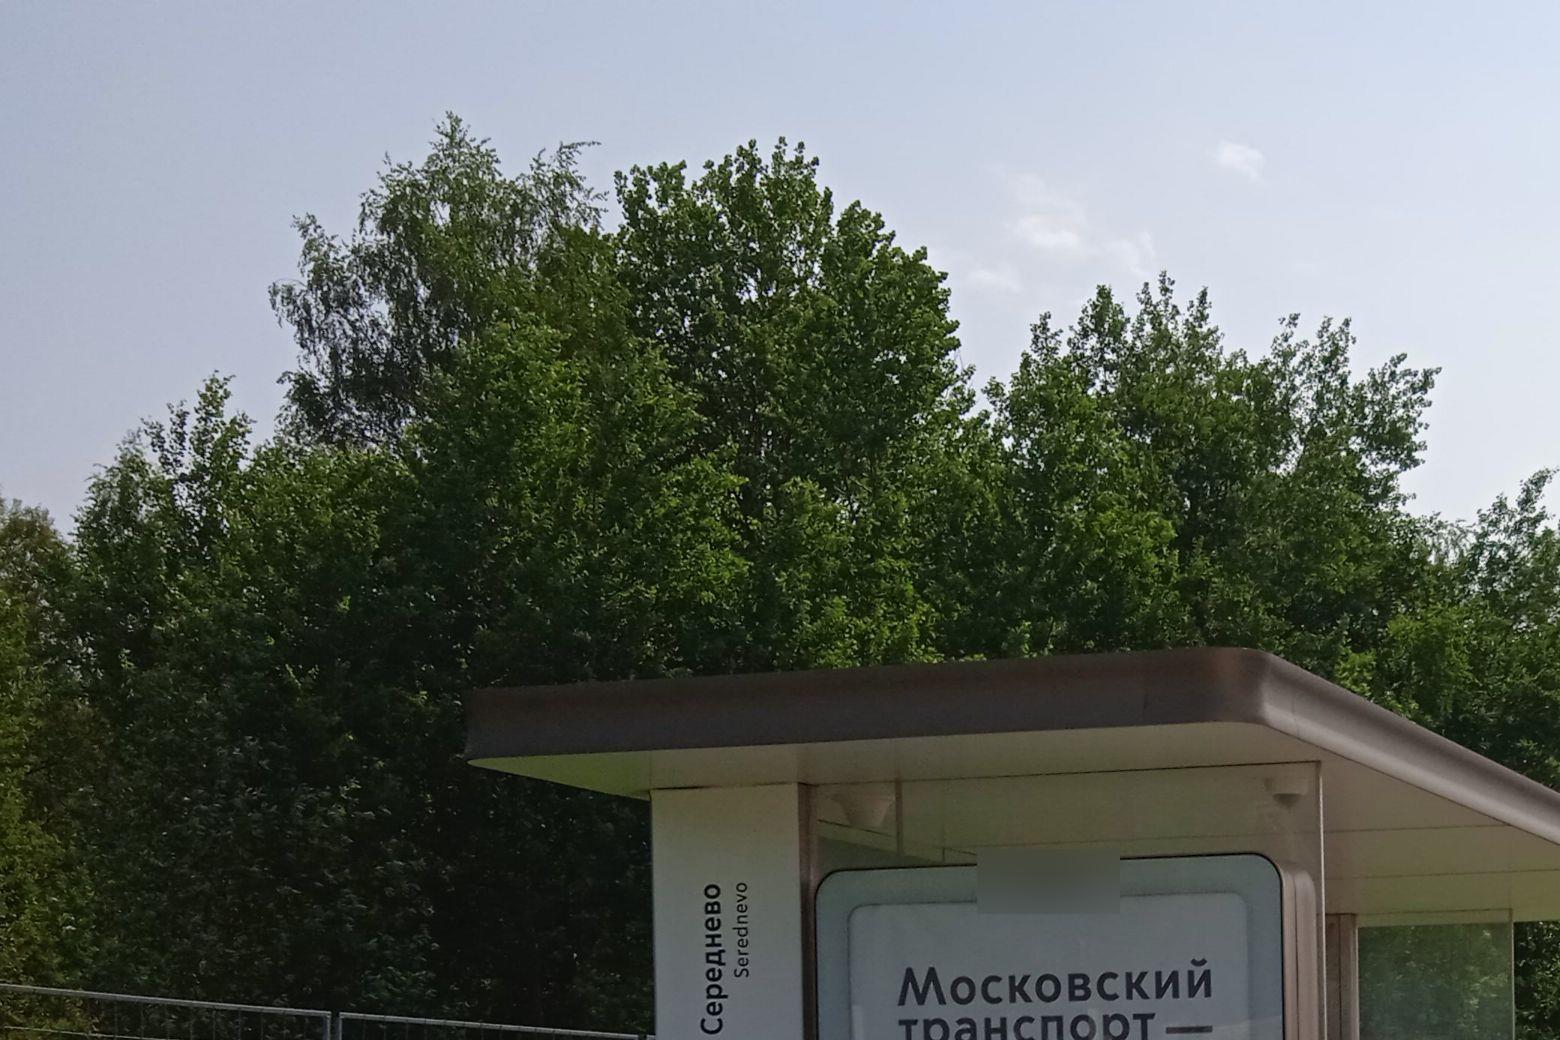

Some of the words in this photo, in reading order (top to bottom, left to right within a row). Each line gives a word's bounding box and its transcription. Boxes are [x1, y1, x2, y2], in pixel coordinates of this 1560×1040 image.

[700, 884, 728, 1034] Середнево
[732, 882, 749, 978] Serednevo
[898, 958, 1212, 1006] Московский
